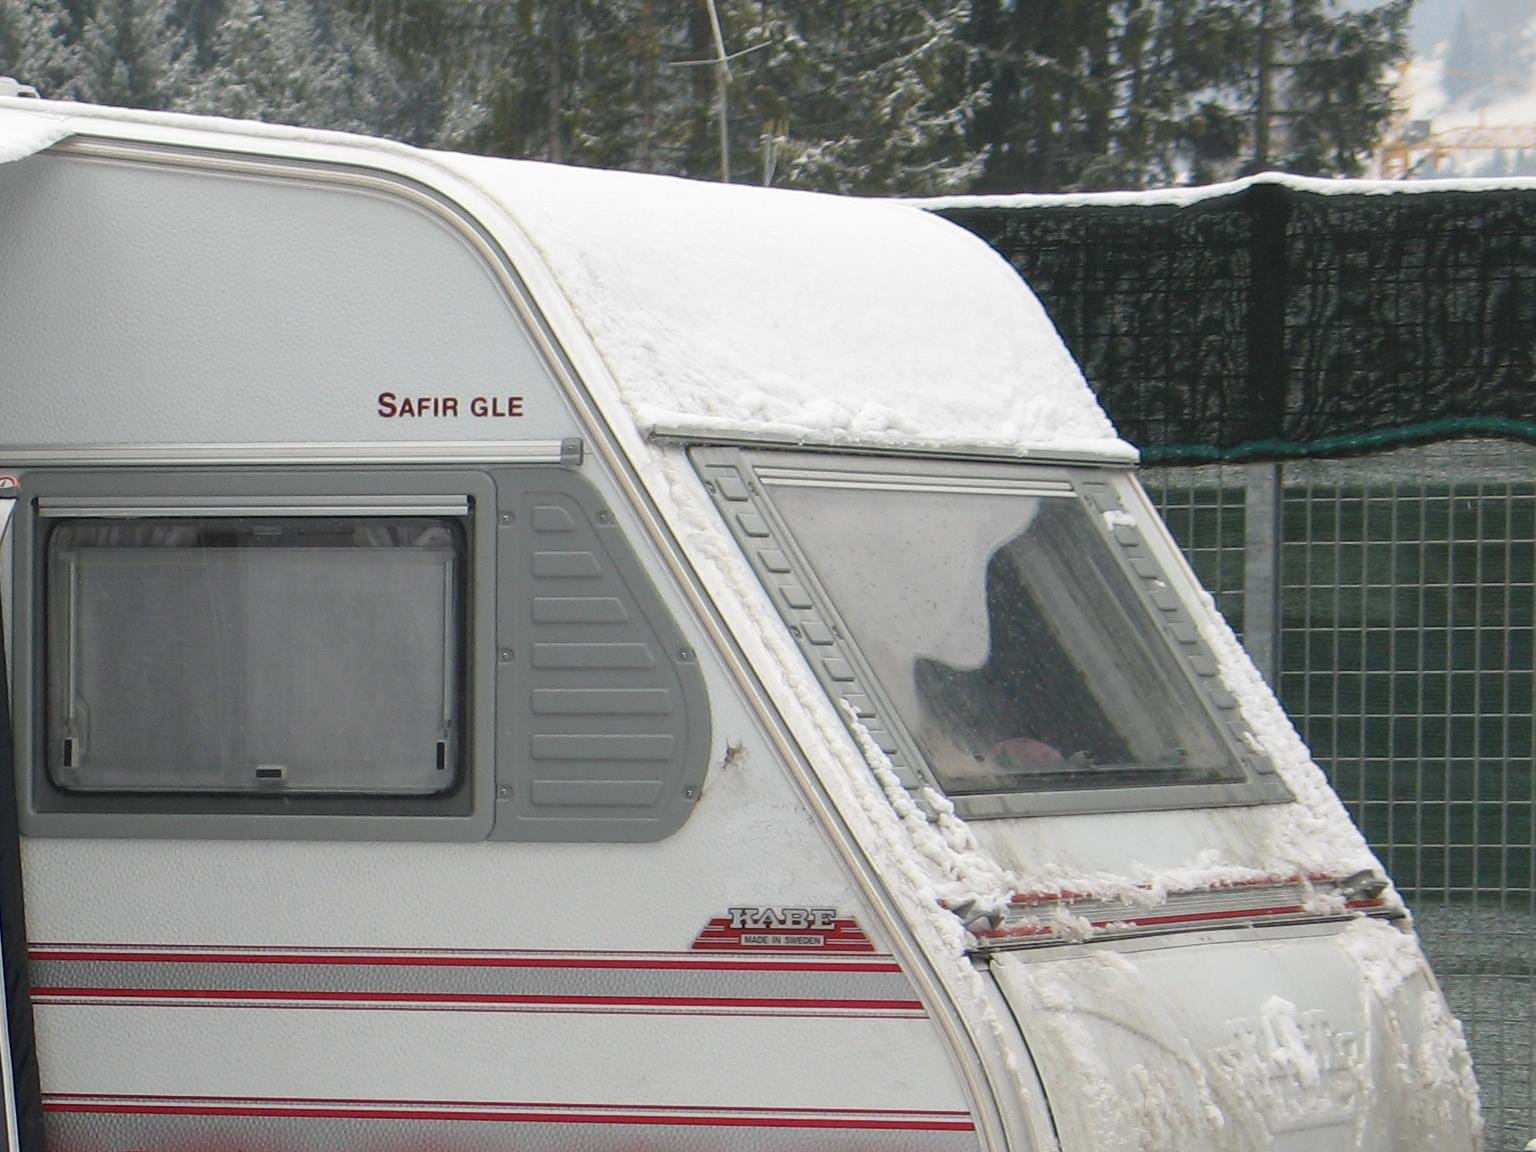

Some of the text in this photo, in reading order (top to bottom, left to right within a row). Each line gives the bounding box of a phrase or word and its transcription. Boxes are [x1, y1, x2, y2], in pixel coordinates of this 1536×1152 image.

[470, 396, 524, 417] GLE
[728, 907, 837, 930] KABE
[744, 935, 821, 946] MADE IN SWEDEN
